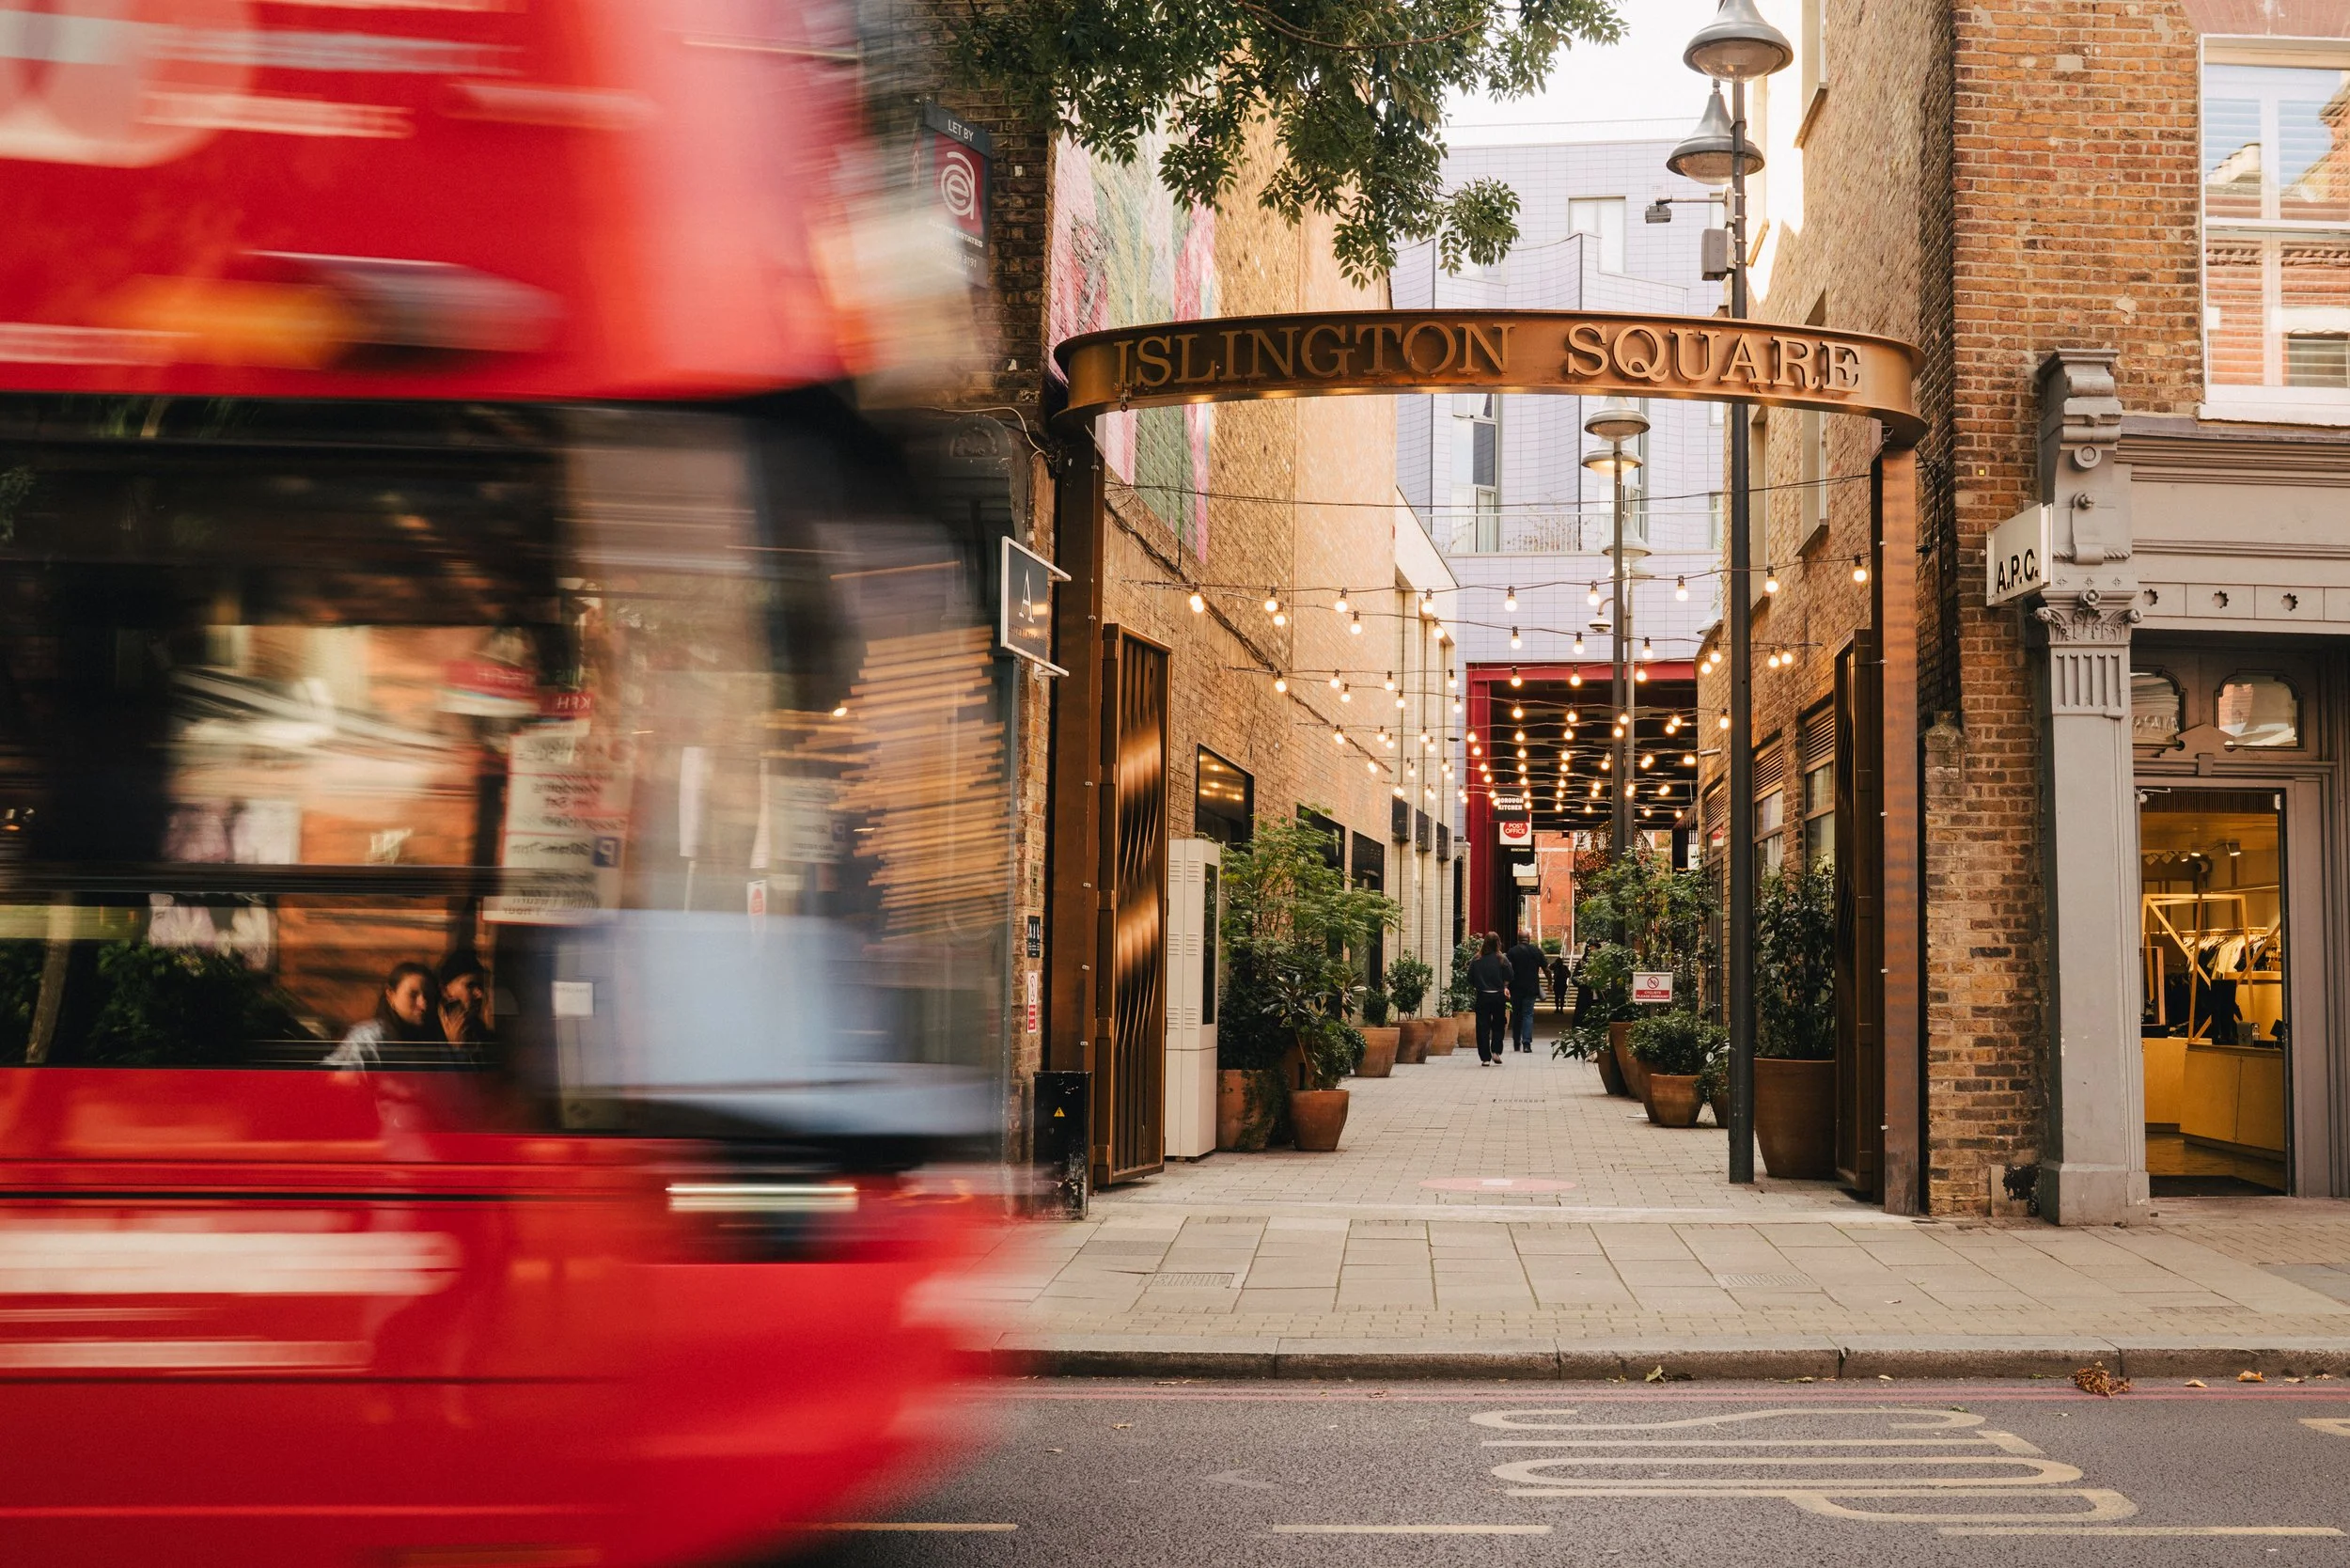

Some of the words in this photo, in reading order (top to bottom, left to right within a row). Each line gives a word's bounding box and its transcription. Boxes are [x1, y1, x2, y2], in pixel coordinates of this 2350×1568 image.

[948, 118, 963, 136] LET
[964, 127, 974, 142] BY
[955, 230, 983, 248] ESTATES
[1114, 321, 1516, 387] ISLINGTON
[1566, 323, 1862, 393] SQUARE
[1997, 548, 2040, 593] A.P.C.
[1018, 569, 1035, 624] A
